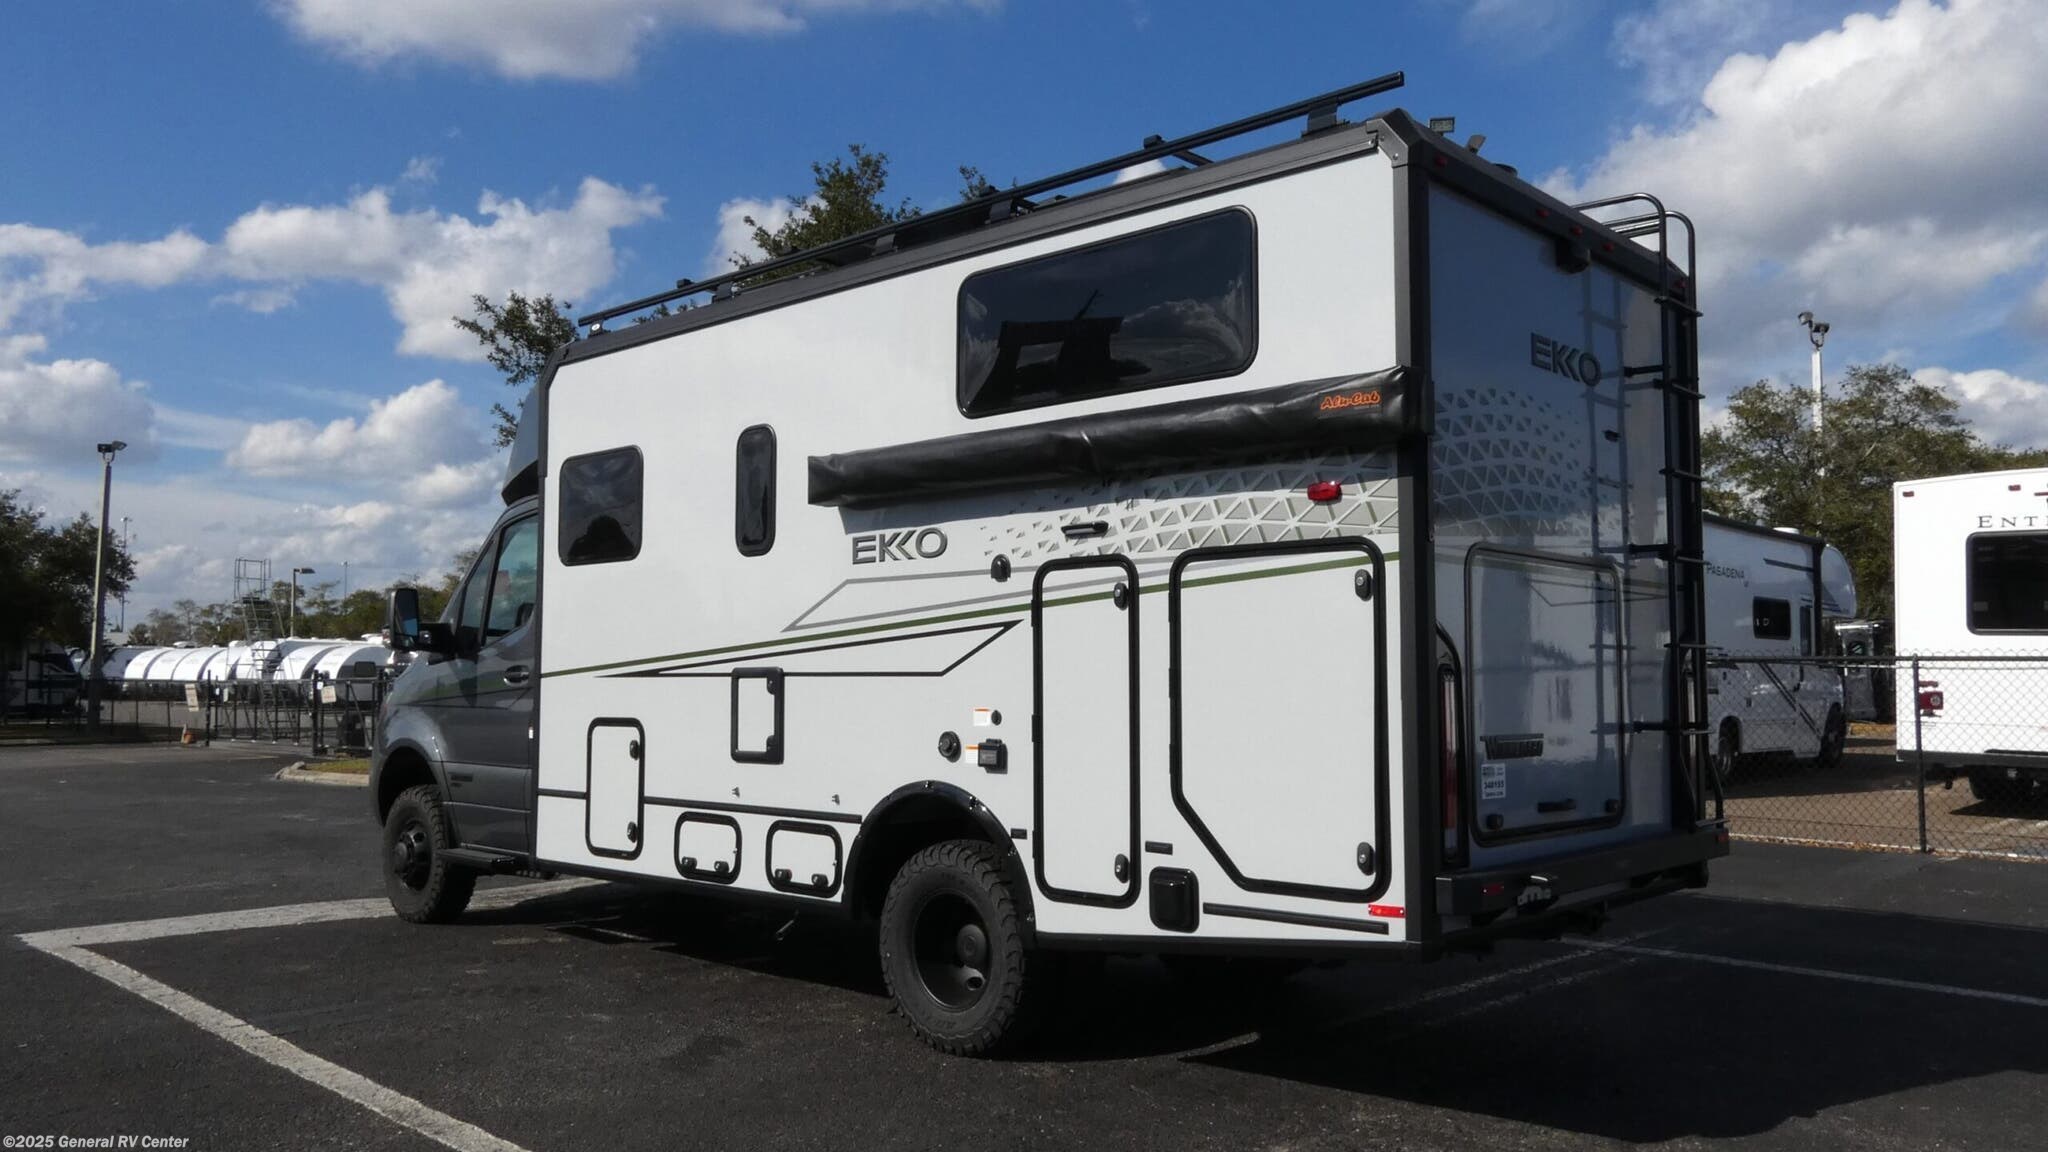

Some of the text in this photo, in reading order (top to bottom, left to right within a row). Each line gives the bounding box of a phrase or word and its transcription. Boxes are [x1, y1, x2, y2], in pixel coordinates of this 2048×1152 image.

[1530, 332, 1602, 387] EKKO
[1977, 514, 2048, 529] ENT
[852, 527, 948, 565] EKKO
